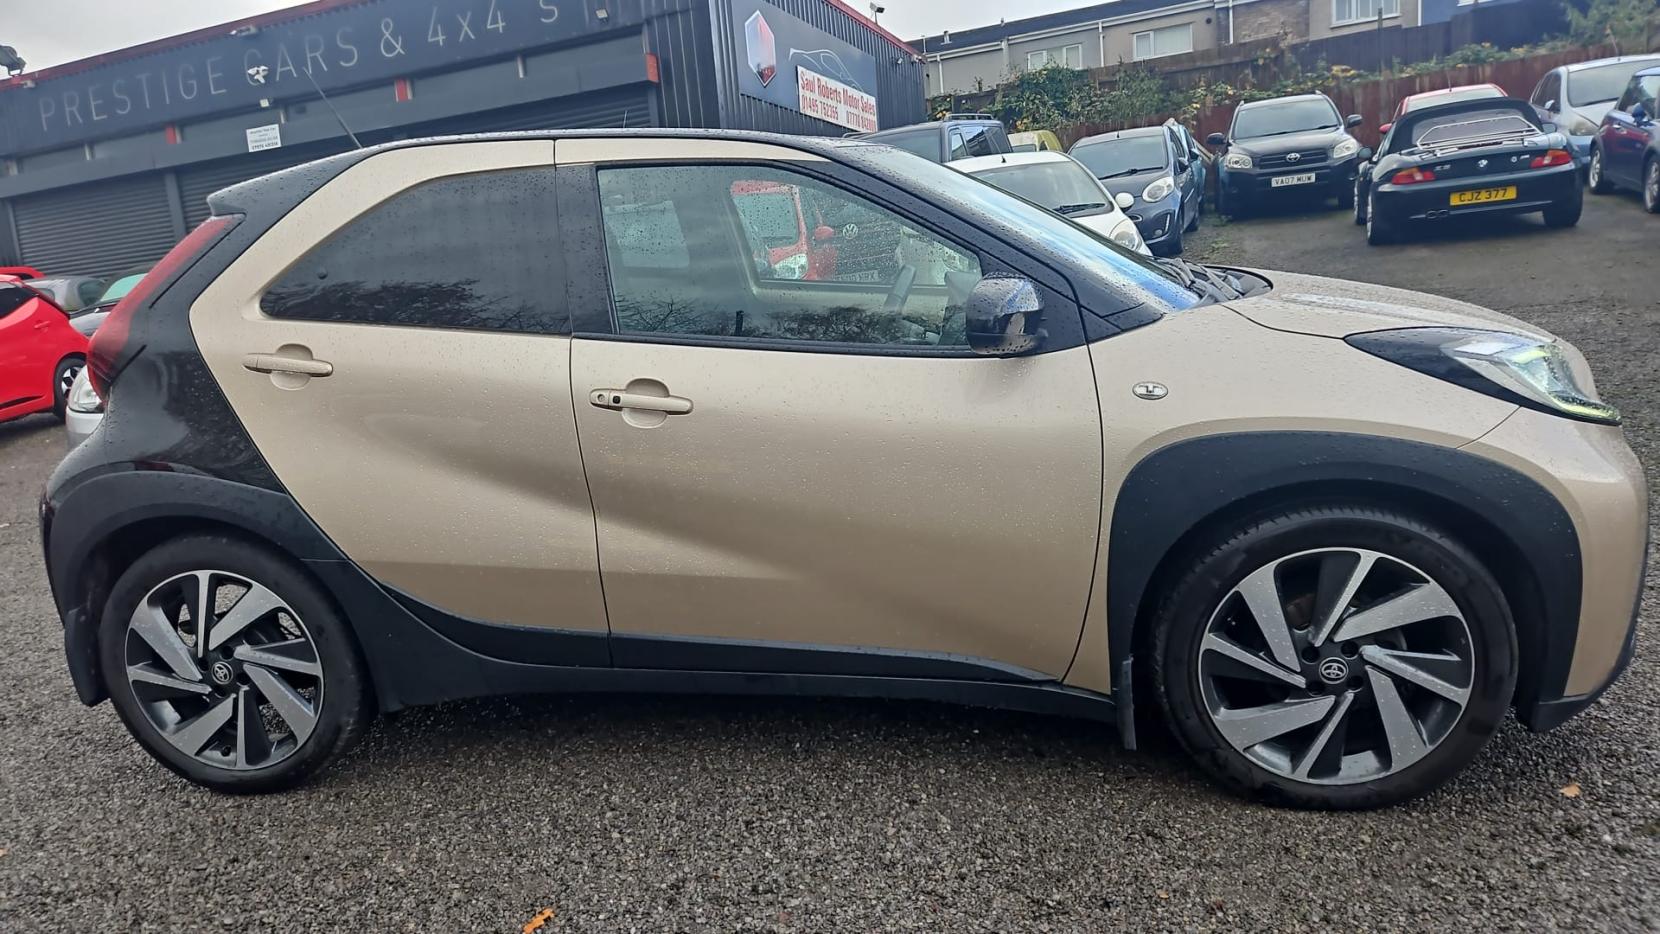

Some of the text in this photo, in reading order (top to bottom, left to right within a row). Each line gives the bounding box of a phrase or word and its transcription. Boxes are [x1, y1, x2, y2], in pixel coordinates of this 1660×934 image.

[38, 55, 227, 131] PRESTIGE
[243, 26, 358, 87] CARS
[380, 17, 406, 57] &
[427, 0, 506, 46] 4x4
[800, 70, 816, 94] Saul
[816, 77, 842, 105] Roberts
[842, 87, 860, 110] Motor
[860, 95, 876, 117] Sales
[1275, 176, 1295, 185] VA07
[1459, 188, 1507, 202] CJZ 377
